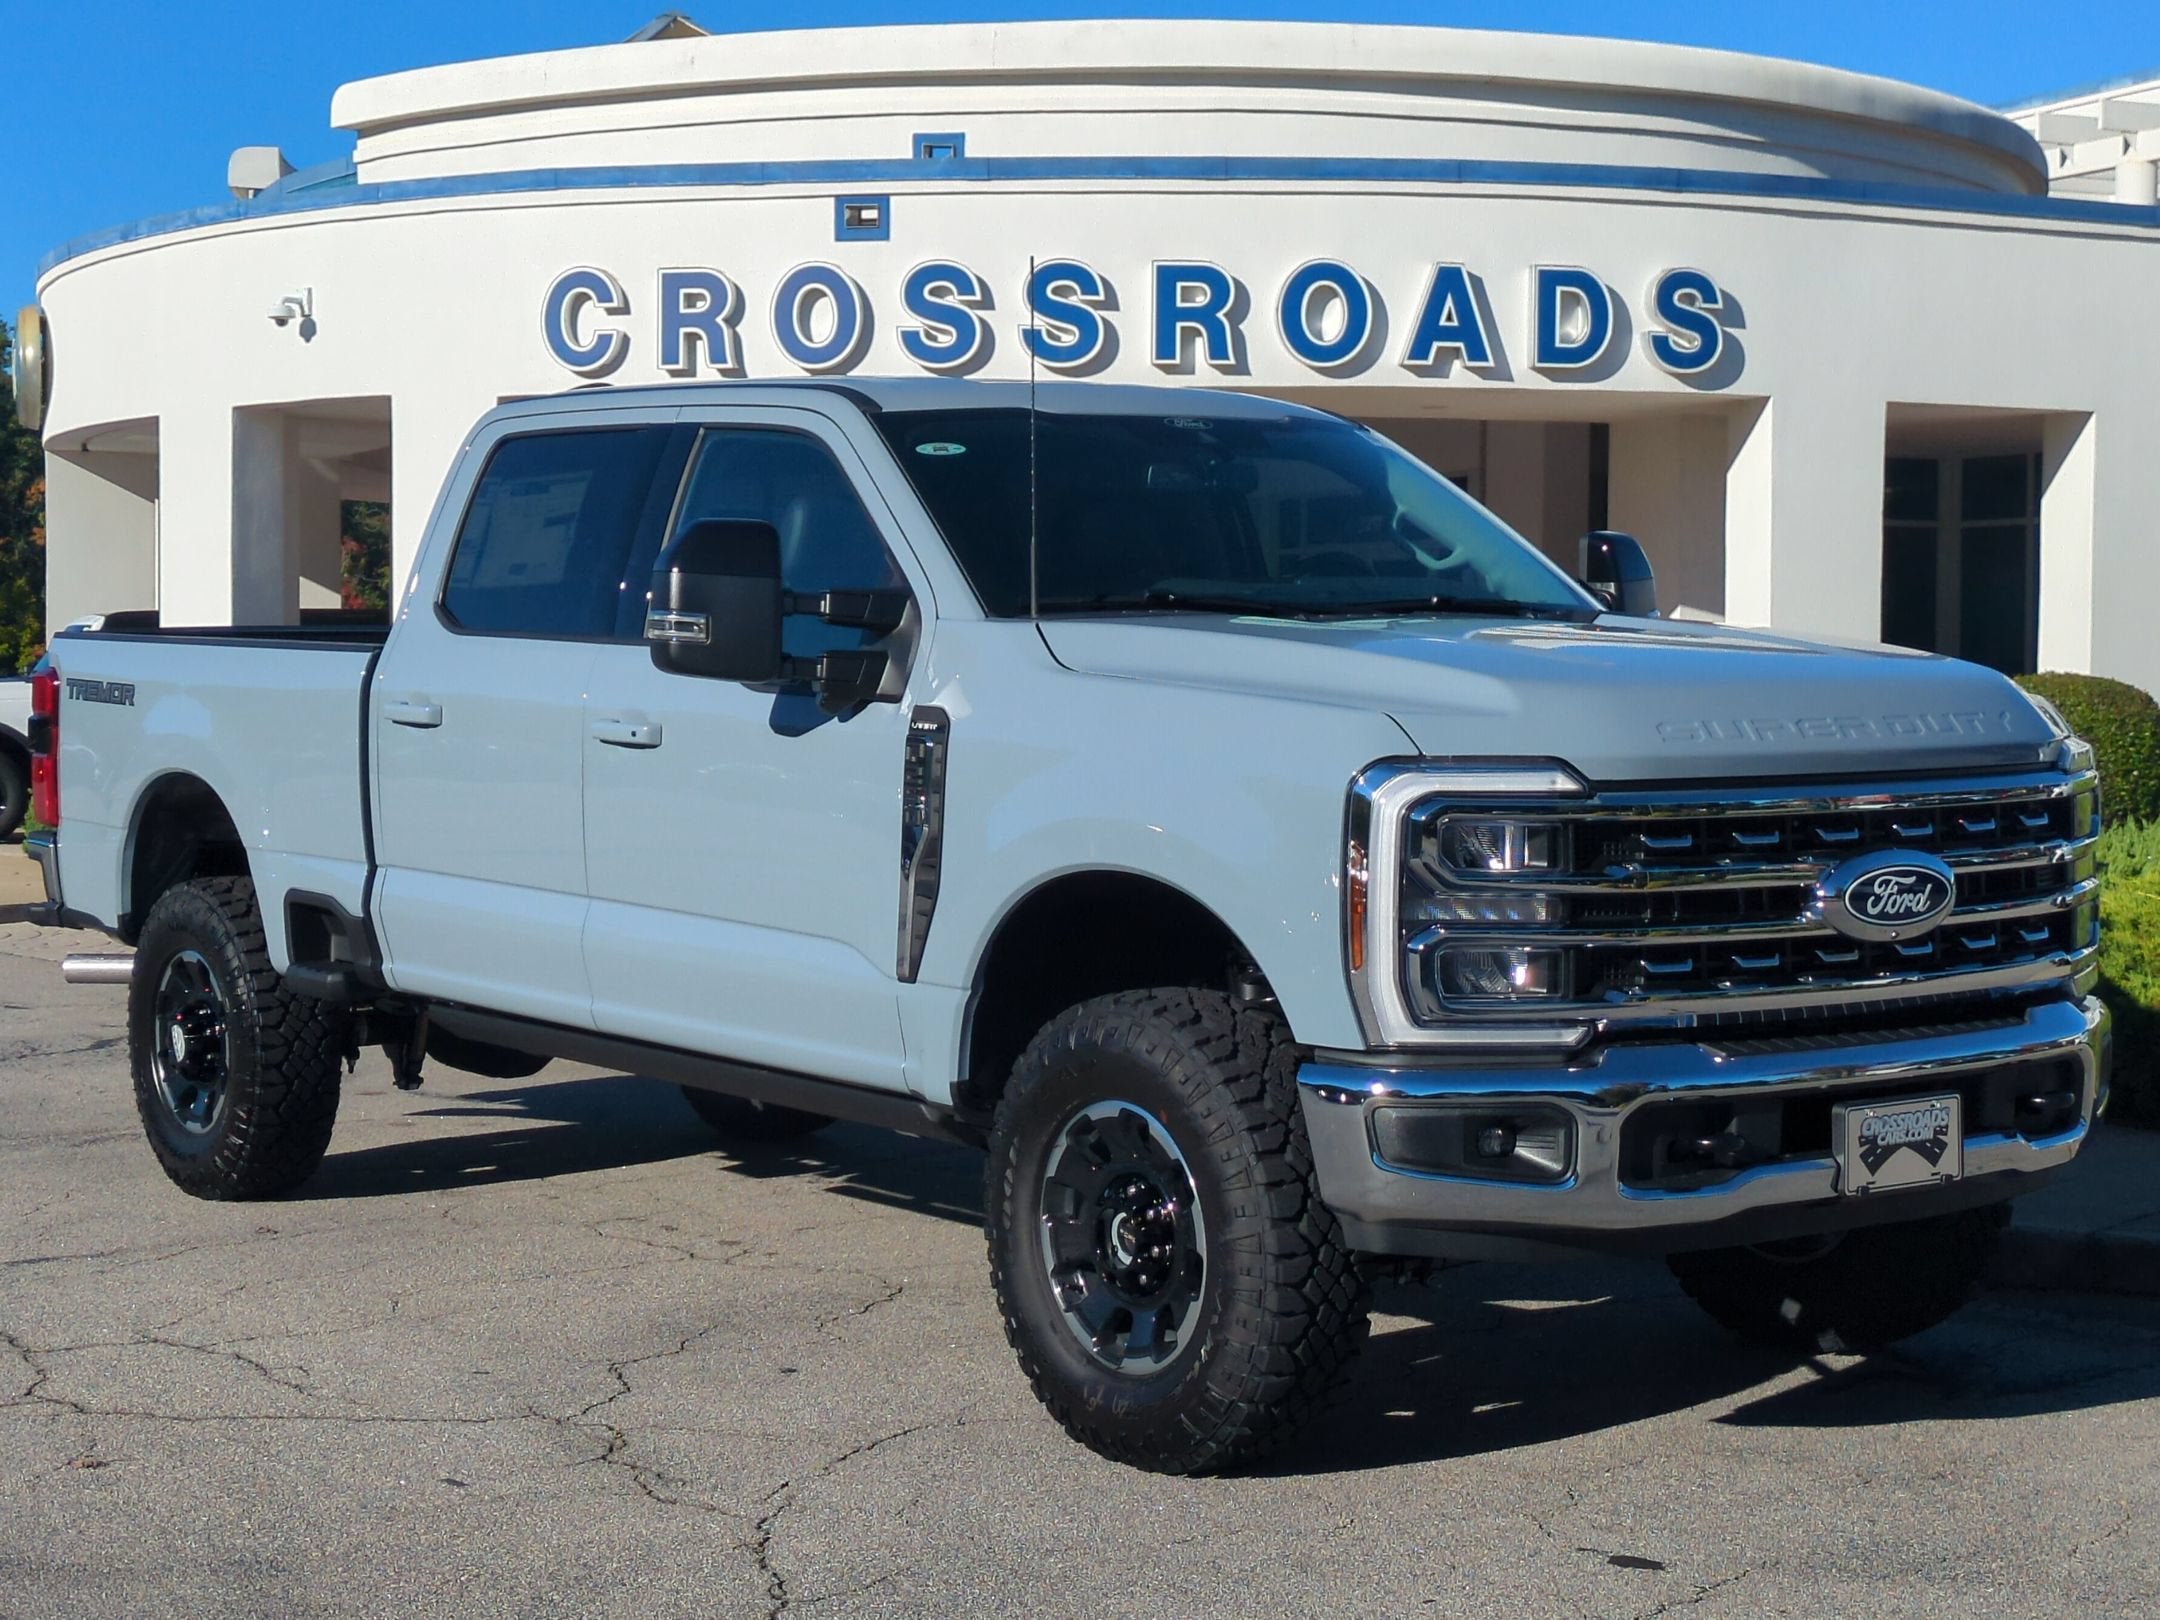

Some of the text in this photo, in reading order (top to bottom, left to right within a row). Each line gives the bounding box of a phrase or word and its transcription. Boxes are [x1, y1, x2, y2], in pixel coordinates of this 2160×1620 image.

[540, 257, 1726, 374] CROSSROADS
[66, 677, 135, 706] TREMOR
[1655, 715, 1881, 743] SUPER
[1866, 875, 1933, 915] Ford
[1861, 1107, 1950, 1137] CROSSROADS
[1876, 1126, 1934, 1146] CARS.COM
